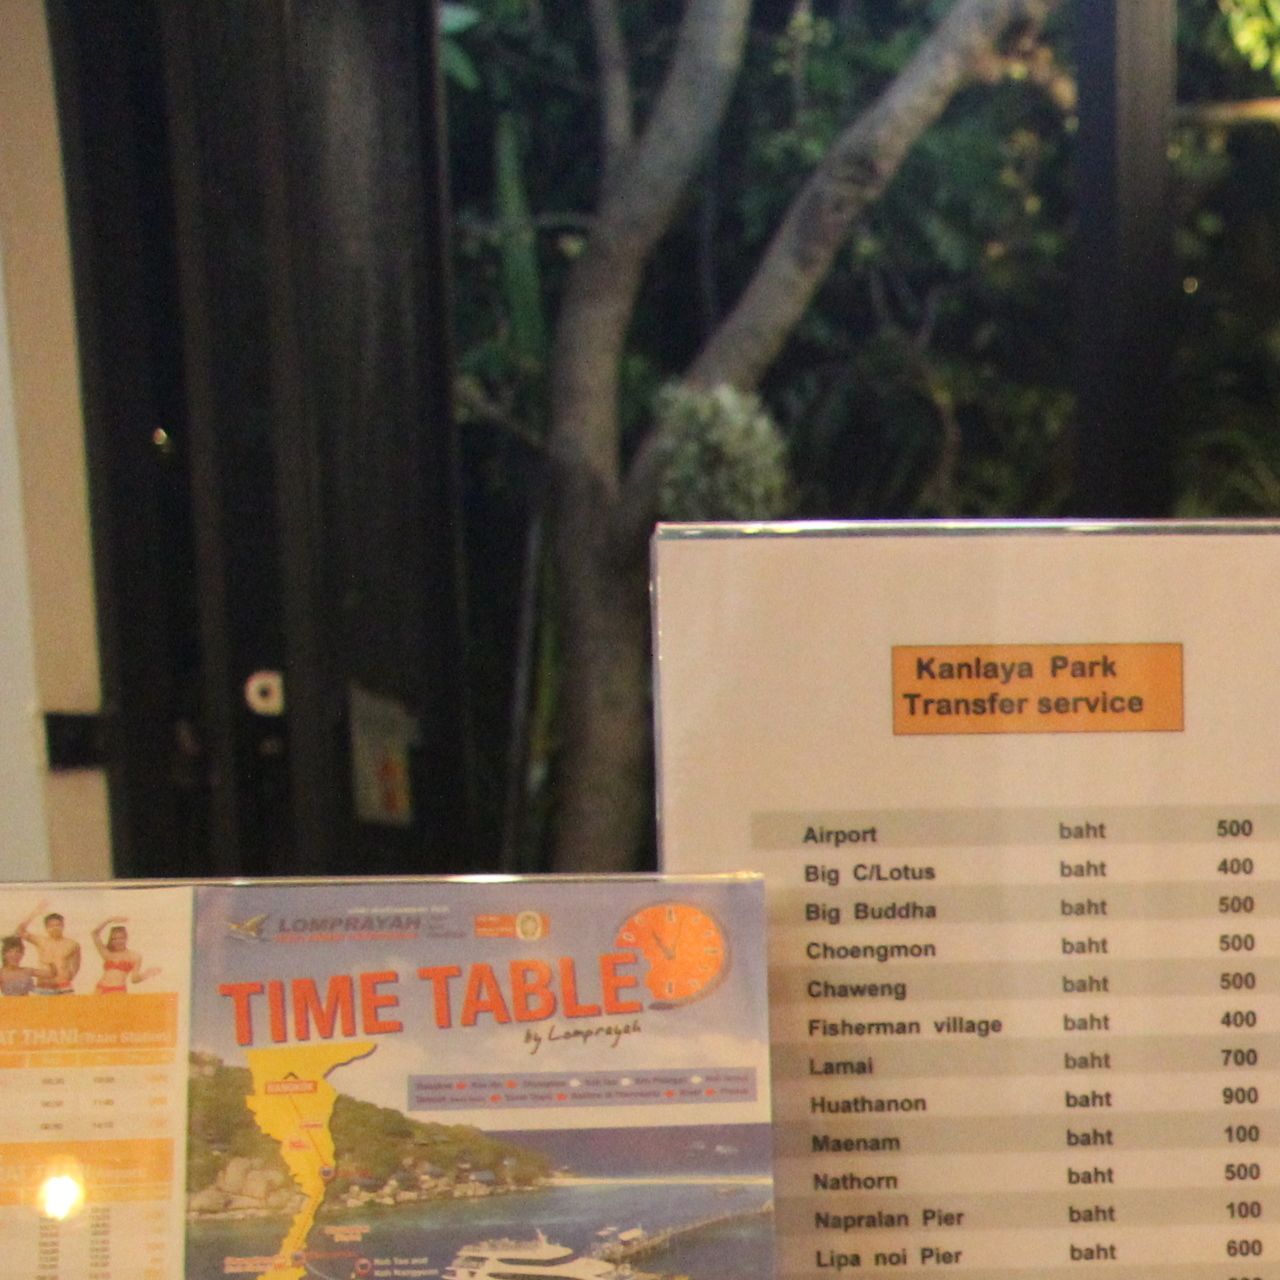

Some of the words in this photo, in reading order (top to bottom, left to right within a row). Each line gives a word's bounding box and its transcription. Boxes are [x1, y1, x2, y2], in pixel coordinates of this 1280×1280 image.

[916, 657, 1033, 683] Kanlaya
[1051, 655, 1116, 678] Park
[903, 693, 1028, 716] Transfer
[1038, 692, 1143, 714] service
[803, 826, 877, 847] Airport
[1059, 822, 1106, 839] baht
[1217, 819, 1253, 837] 500
[805, 865, 839, 886] Big
[853, 864, 936, 881] C/Lotus
[1060, 861, 1106, 877] baht
[1218, 858, 1254, 875] 400
[278, 914, 421, 934] LOMPRAYAH
[805, 903, 841, 925] Big
[854, 902, 937, 920] Buddha
[1061, 899, 1107, 916] baht
[1219, 896, 1255, 913] 500
[806, 942, 936, 963] Choengmon
[1062, 938, 1107, 954] baht
[1220, 934, 1255, 951] 500
[218, 970, 404, 1046] TIME
[418, 952, 644, 1029] TABLE
[807, 980, 907, 1001] Chaweng
[1062, 976, 1109, 993] baht
[1220, 972, 1256, 990] 500
[524, 1028, 543, 1054] by
[548, 1021, 642, 1048] Lomprayah
[809, 1019, 920, 1036] Fisherman
[934, 1017, 1002, 1037] village
[1064, 1014, 1109, 1031] baht
[1221, 1011, 1257, 1027] 400
[810, 1057, 874, 1075] Lamai
[1064, 1052, 1111, 1069] baht
[1221, 1048, 1258, 1066] 700
[811, 1097, 926, 1113] Huathanon
[1065, 1091, 1112, 1108] baht
[1222, 1087, 1259, 1104] 900
[812, 1135, 901, 1152] Maenam
[1066, 1128, 1113, 1147] baht
[1225, 1125, 1260, 1143] 100
[814, 1173, 898, 1190] Nathorn
[1068, 1167, 1113, 1184] baht
[1225, 1163, 1260, 1181] 500
[922, 1209, 965, 1226] Pier
[1068, 1205, 1115, 1223] baht
[1226, 1201, 1262, 1219] 100
[816, 1251, 861, 1270] Lipa
[875, 1249, 907, 1265] noi
[921, 1248, 962, 1264] Pier
[1070, 1244, 1116, 1261] baht
[1227, 1239, 1263, 1257] 600
